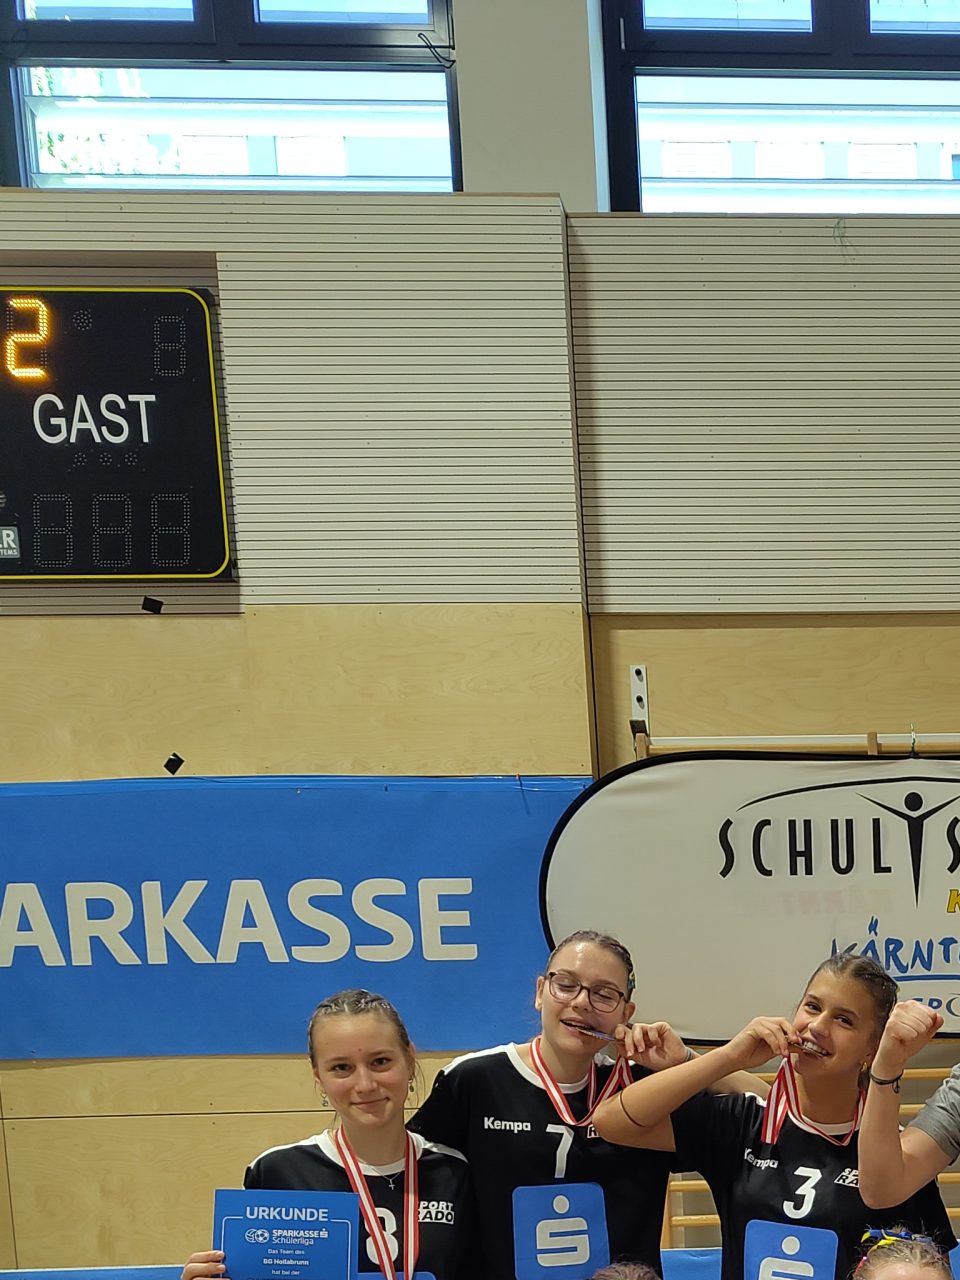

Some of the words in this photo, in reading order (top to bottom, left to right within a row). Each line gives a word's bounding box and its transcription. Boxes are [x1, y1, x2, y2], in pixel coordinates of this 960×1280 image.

[5, 298, 49, 379] 2
[33, 394, 156, 444] GAST
[718, 817, 893, 879] SCHUL
[484, 1117, 532, 1134] Kempa
[545, 1123, 575, 1179] 7
[246, 1206, 327, 1221] URKUNDE
[783, 1166, 822, 1219] 3
[272, 1237, 314, 1245] Schülerliga
[273, 1229, 319, 1237] SPARKASSE
